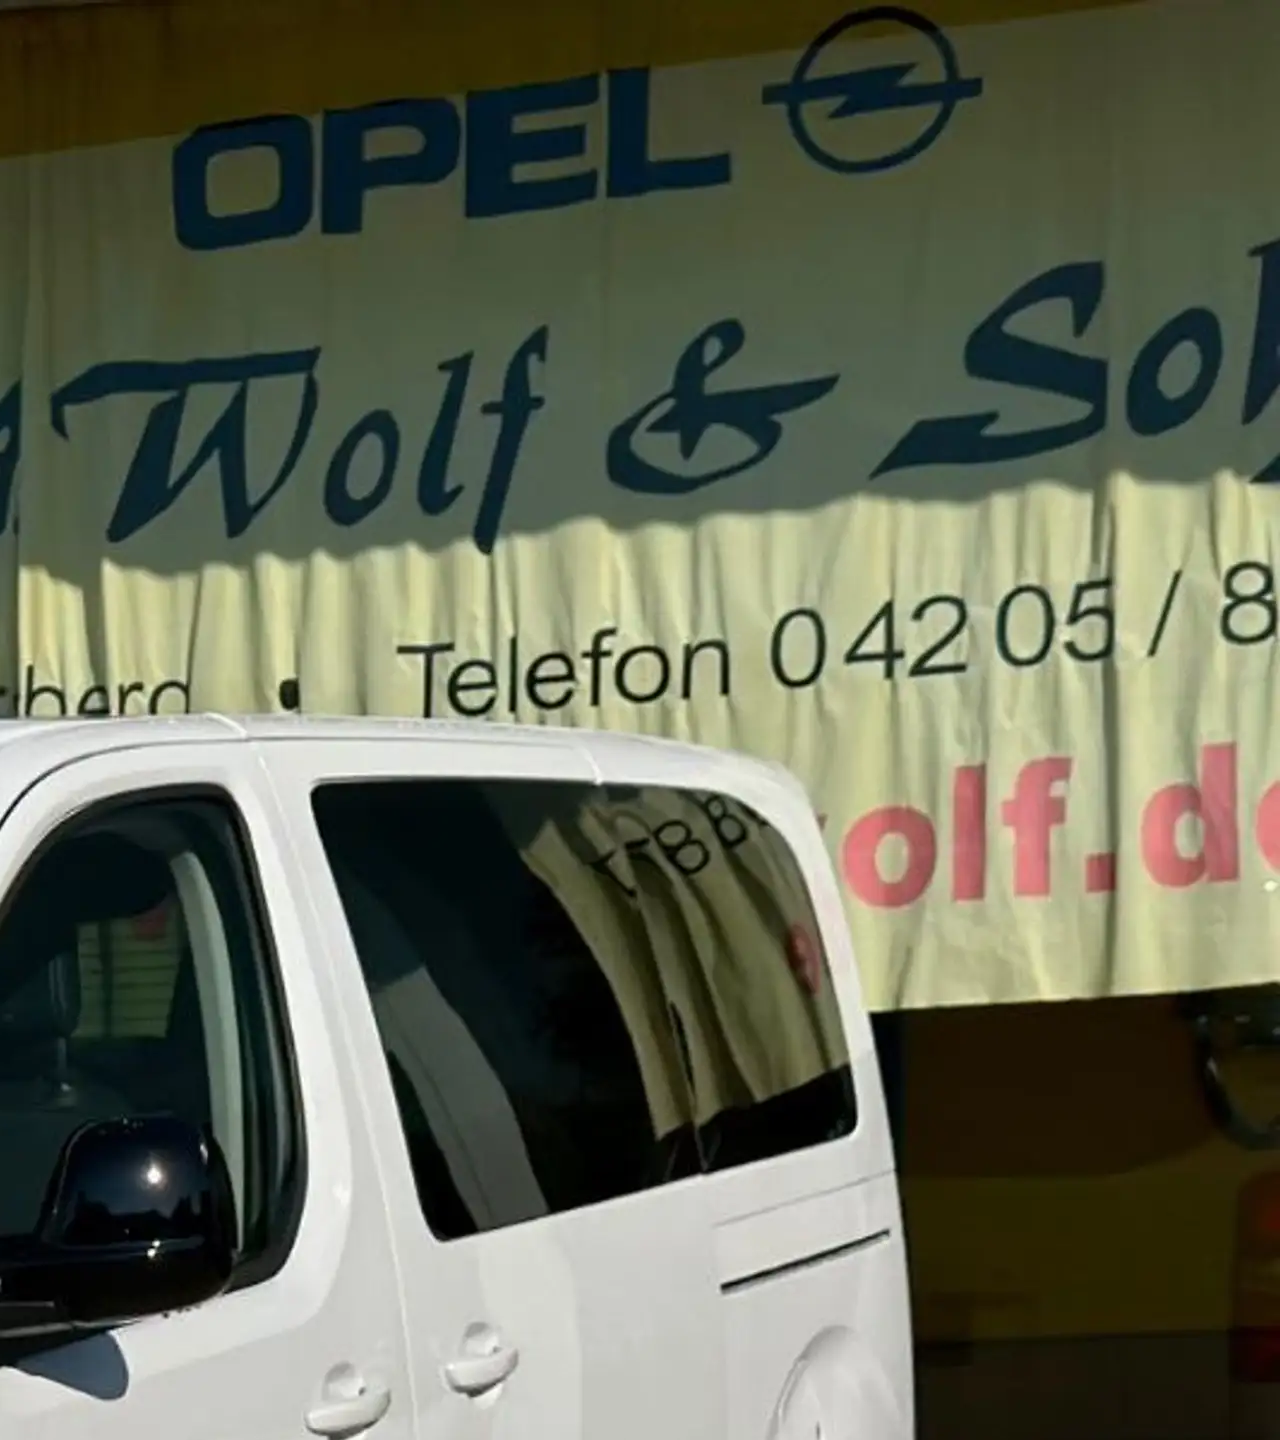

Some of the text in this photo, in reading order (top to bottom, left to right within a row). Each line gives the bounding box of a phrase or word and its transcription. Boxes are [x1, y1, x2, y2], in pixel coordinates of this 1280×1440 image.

[172, 64, 733, 252] OPEL
[50, 324, 548, 556] Wolf
[604, 316, 841, 495] &
[396, 626, 732, 719] Telefon
